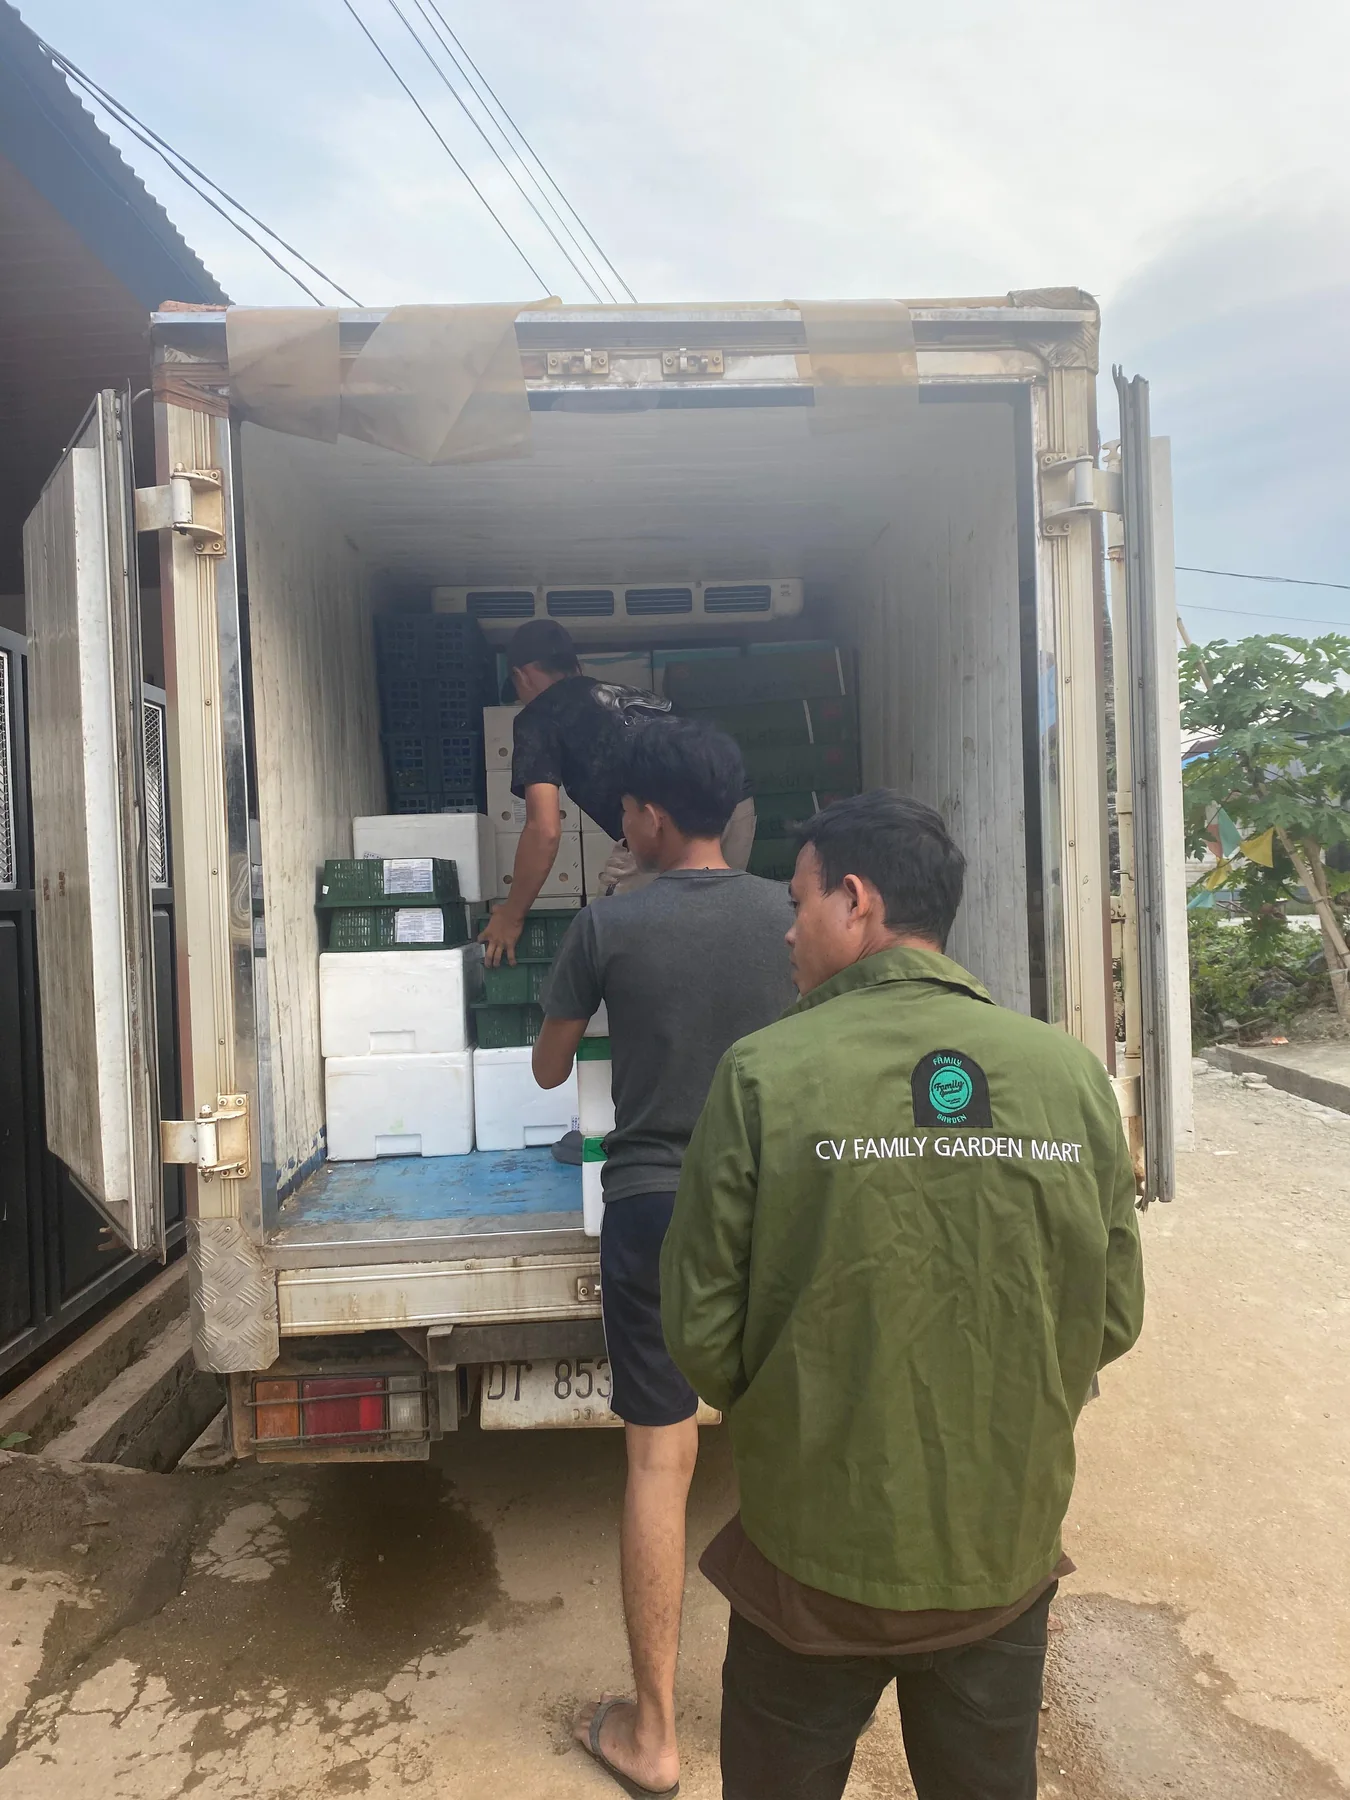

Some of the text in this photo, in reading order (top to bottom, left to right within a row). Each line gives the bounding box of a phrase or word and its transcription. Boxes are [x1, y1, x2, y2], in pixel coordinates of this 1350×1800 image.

[933, 1056, 963, 1067] FAMILY
[937, 1113, 967, 1124] GARDEN
[815, 1136, 1082, 1163] CV FAMILY GARDEN MART
[487, 1360, 528, 1401] DT
